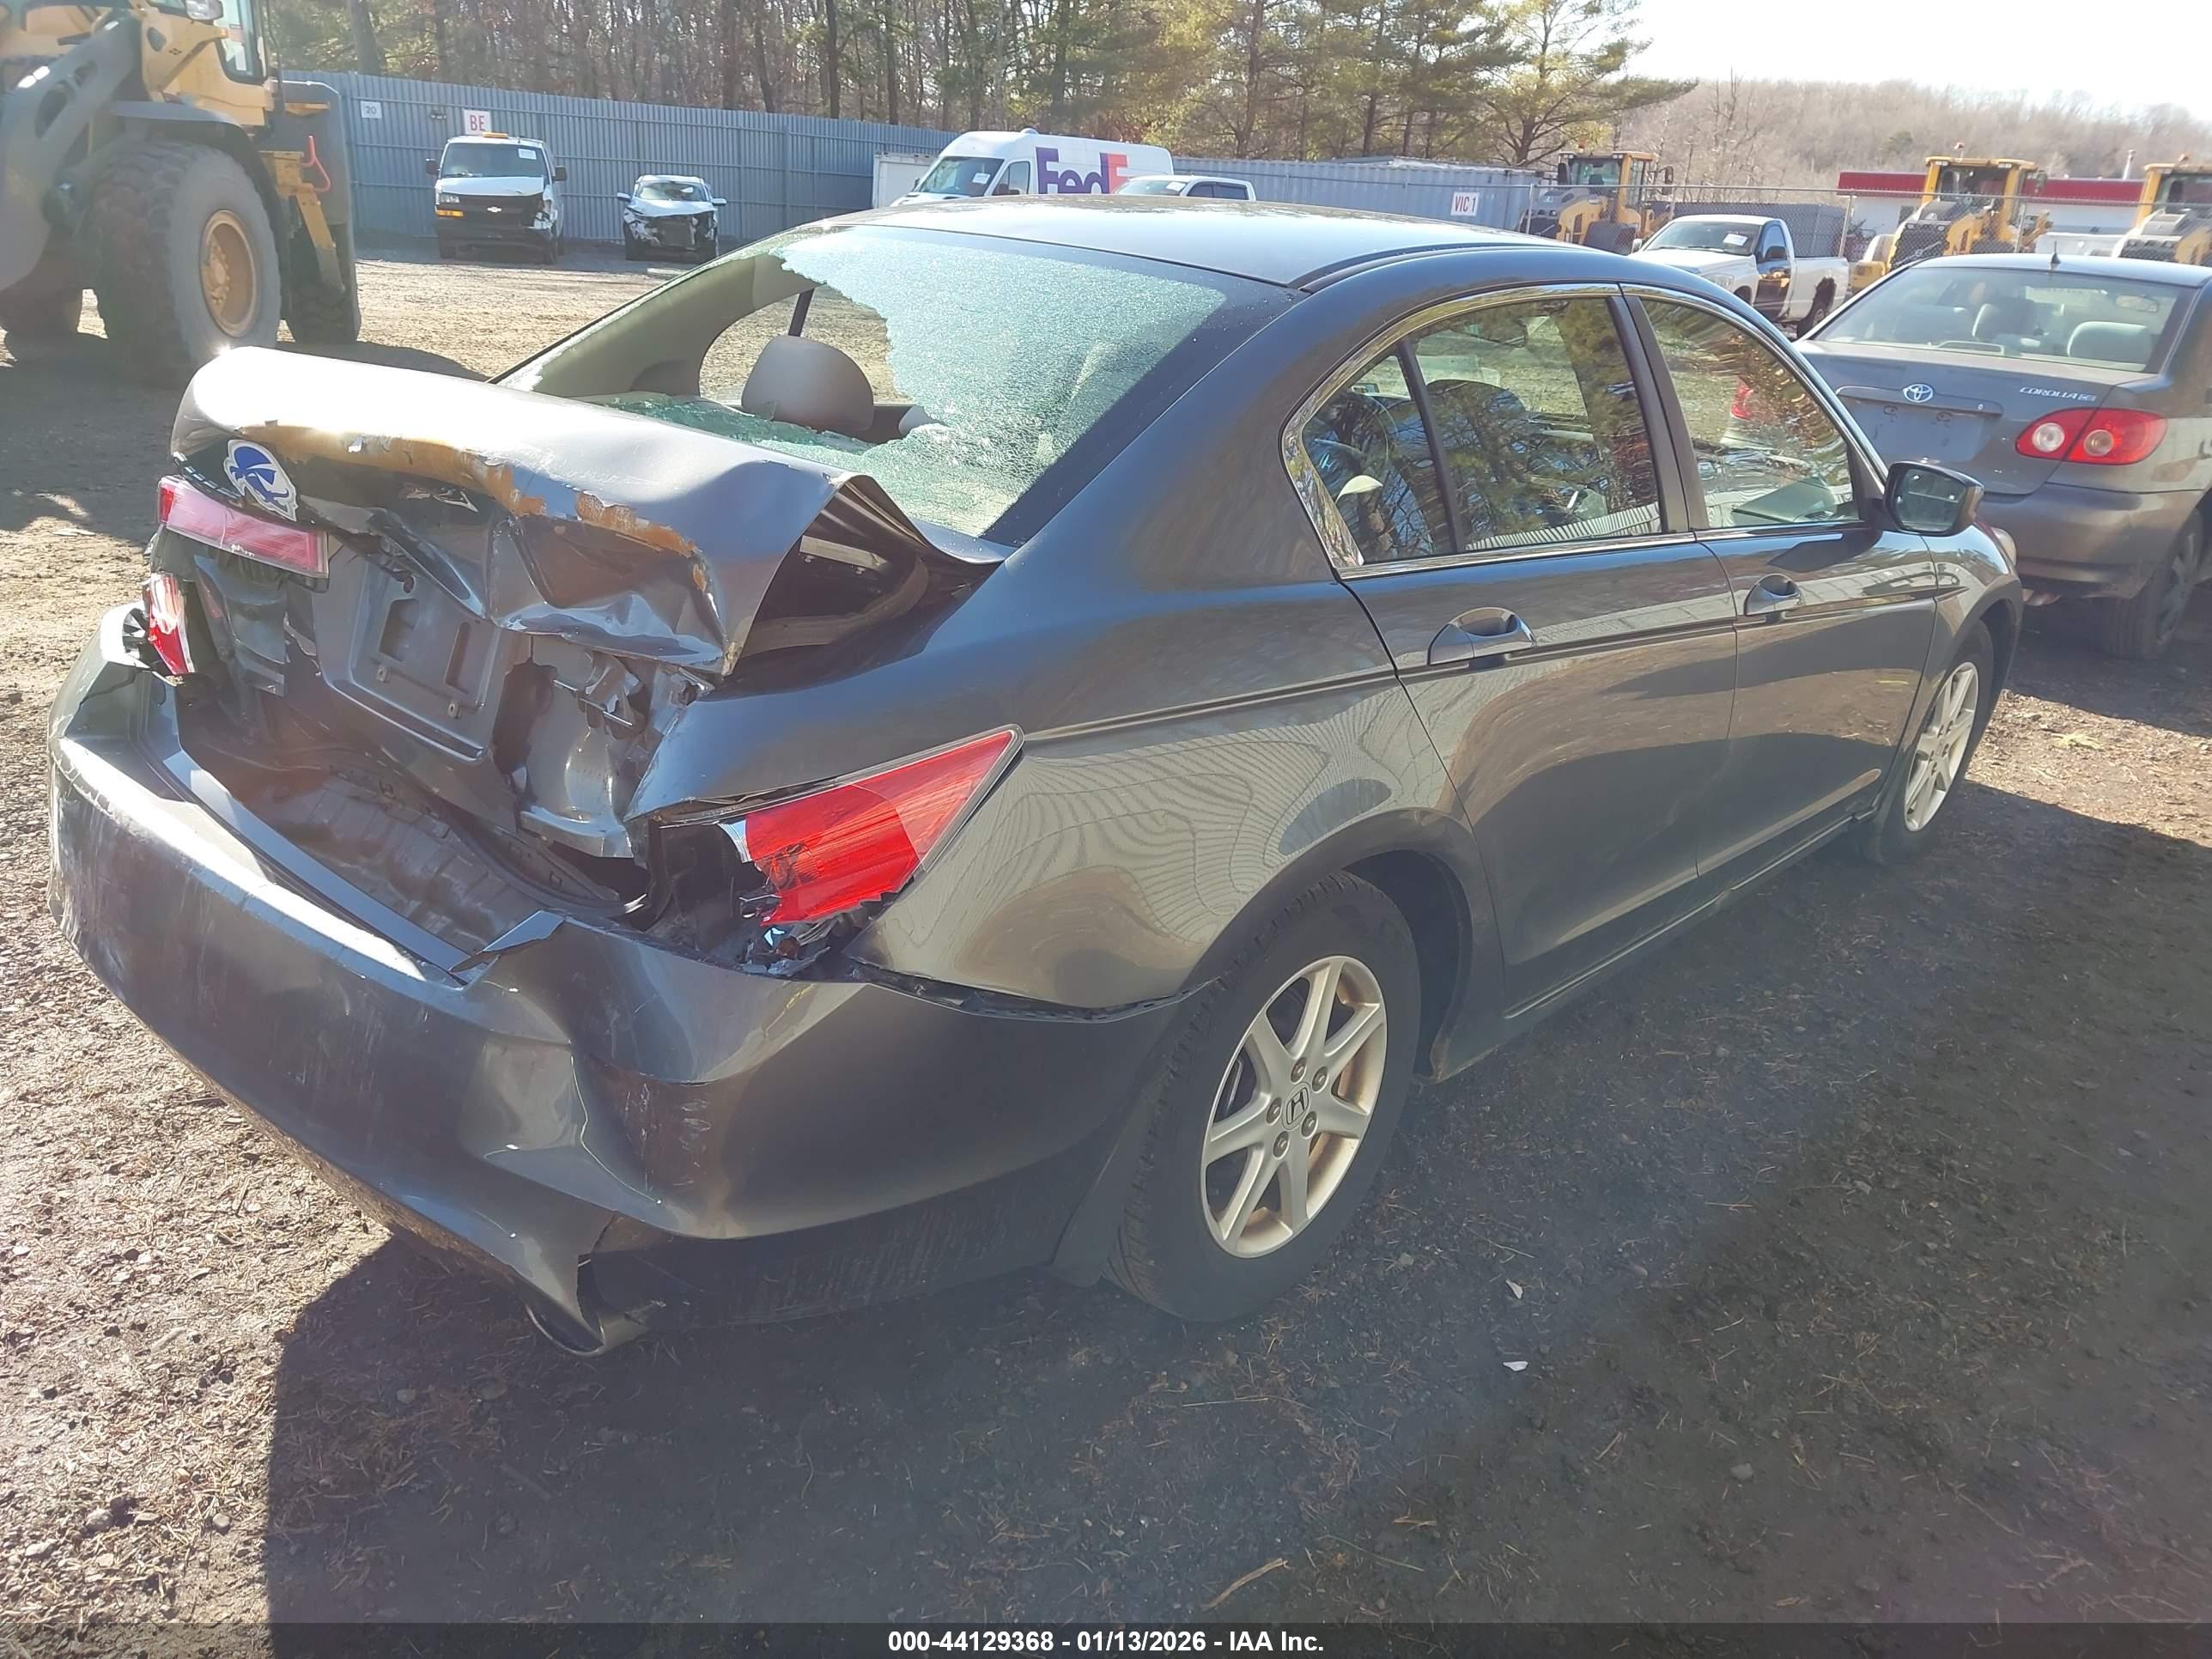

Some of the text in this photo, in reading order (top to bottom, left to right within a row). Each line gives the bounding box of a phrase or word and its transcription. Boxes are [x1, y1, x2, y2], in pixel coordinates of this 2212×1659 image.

[365, 106, 377, 115] 20
[470, 114, 486, 131] BE
[1036, 147, 1128, 194] FedE
[1455, 196, 1477, 213] VIC 1
[2019, 386, 2078, 399] COROLLA
